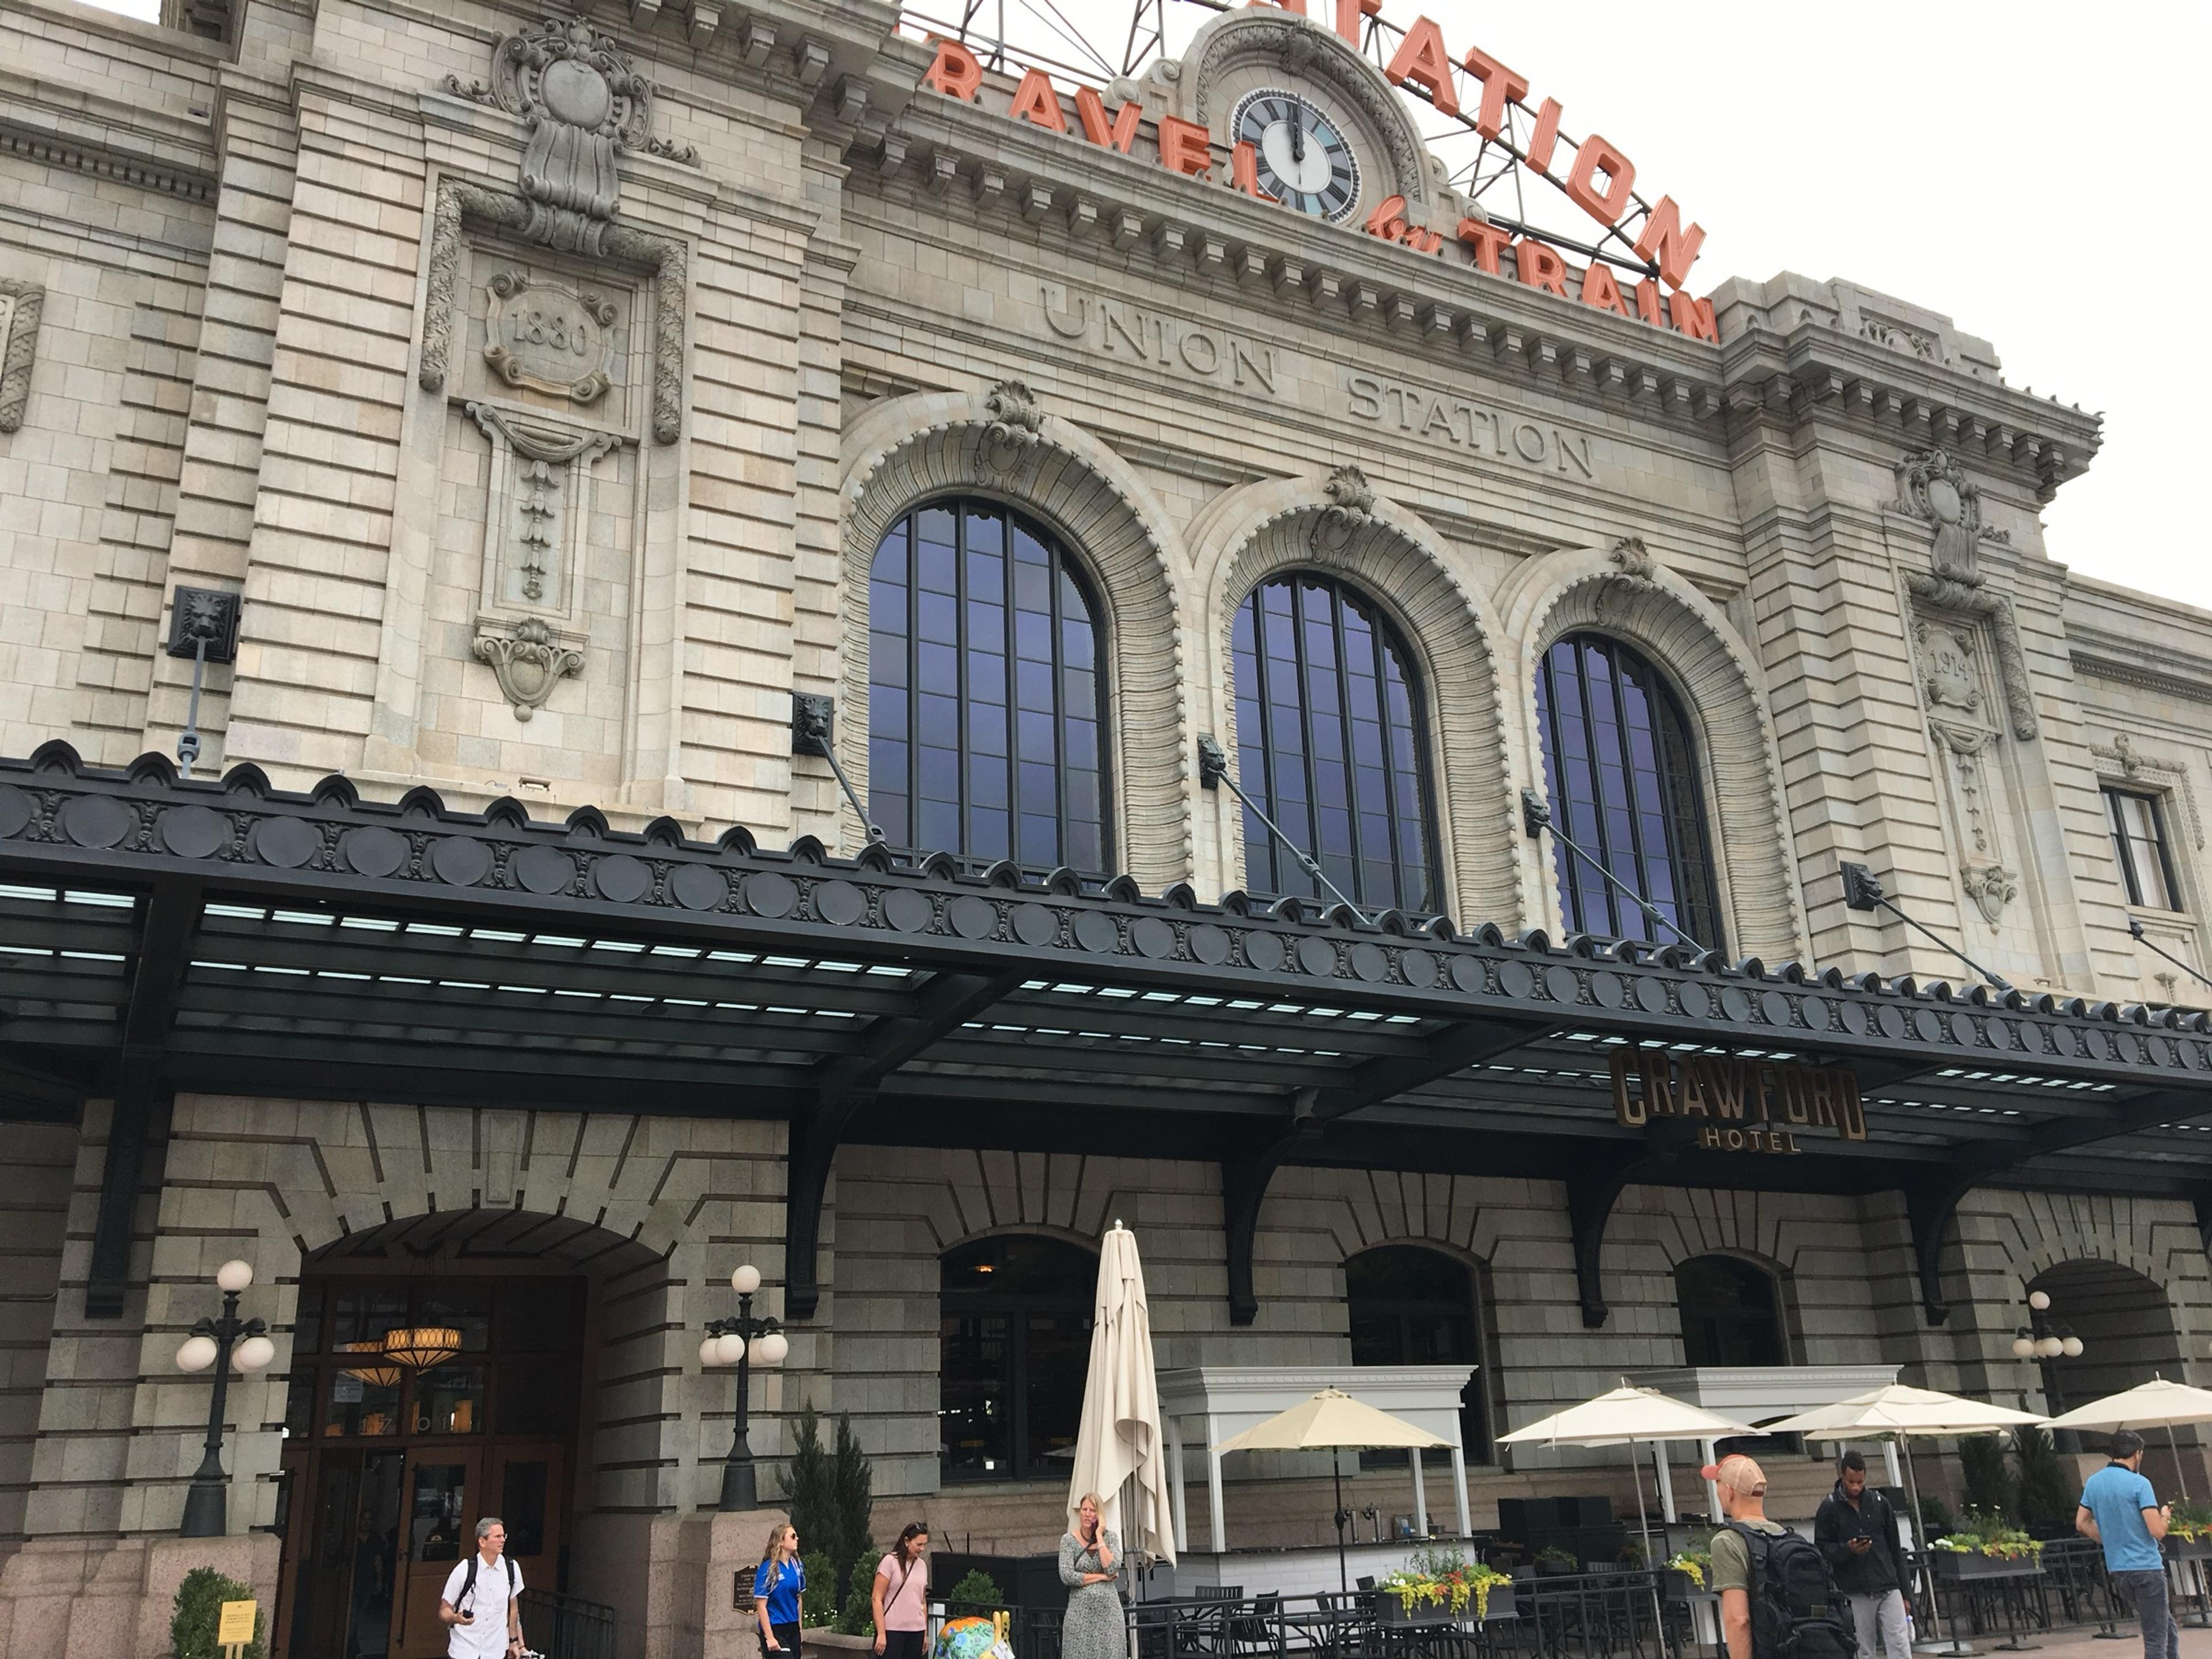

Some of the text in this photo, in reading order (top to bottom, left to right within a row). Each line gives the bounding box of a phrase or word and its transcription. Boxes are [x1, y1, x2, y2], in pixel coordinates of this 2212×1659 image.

[1457, 218, 1719, 344] TRAIN
[511, 310, 588, 357] 1880
[1040, 286, 1594, 479] UNION STATION
[1929, 649, 1969, 681] 1914
[1611, 1047, 1867, 1141] CRAWFORD
[1701, 1127, 1802, 1152] HOTEL
